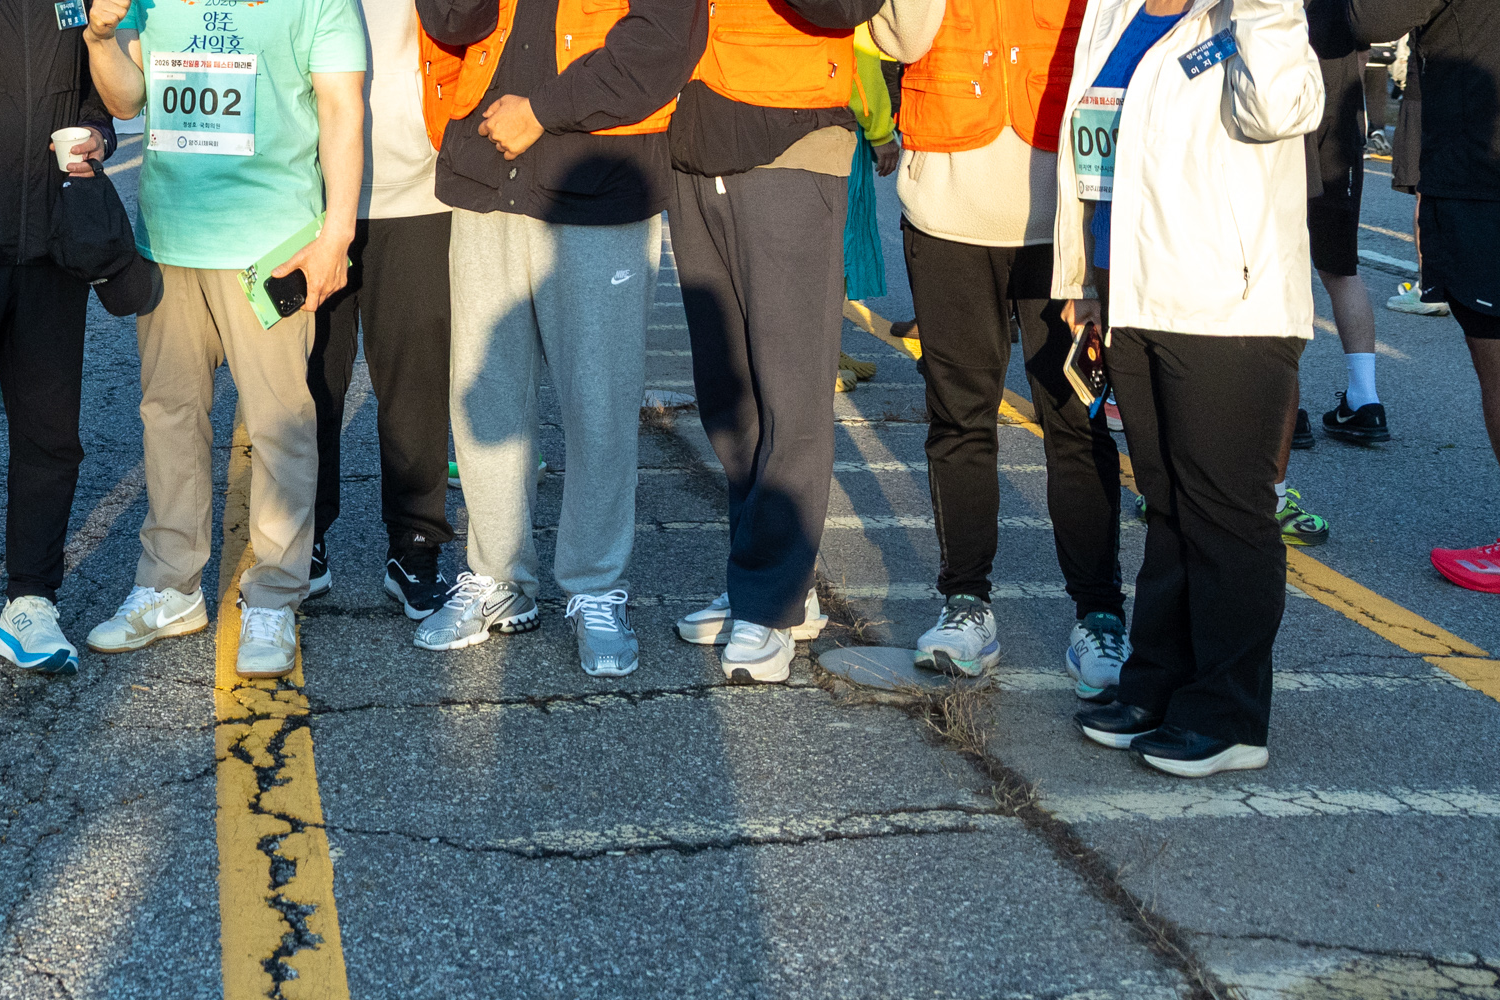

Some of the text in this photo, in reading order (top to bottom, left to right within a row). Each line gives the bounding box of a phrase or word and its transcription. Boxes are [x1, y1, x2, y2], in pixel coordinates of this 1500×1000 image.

[203, 11, 238, 32] 양주
[154, 59, 170, 67] 2026
[171, 59, 182, 68] 양주
[183, 60, 200, 68] 천일홍
[162, 86, 241, 116] 0002
